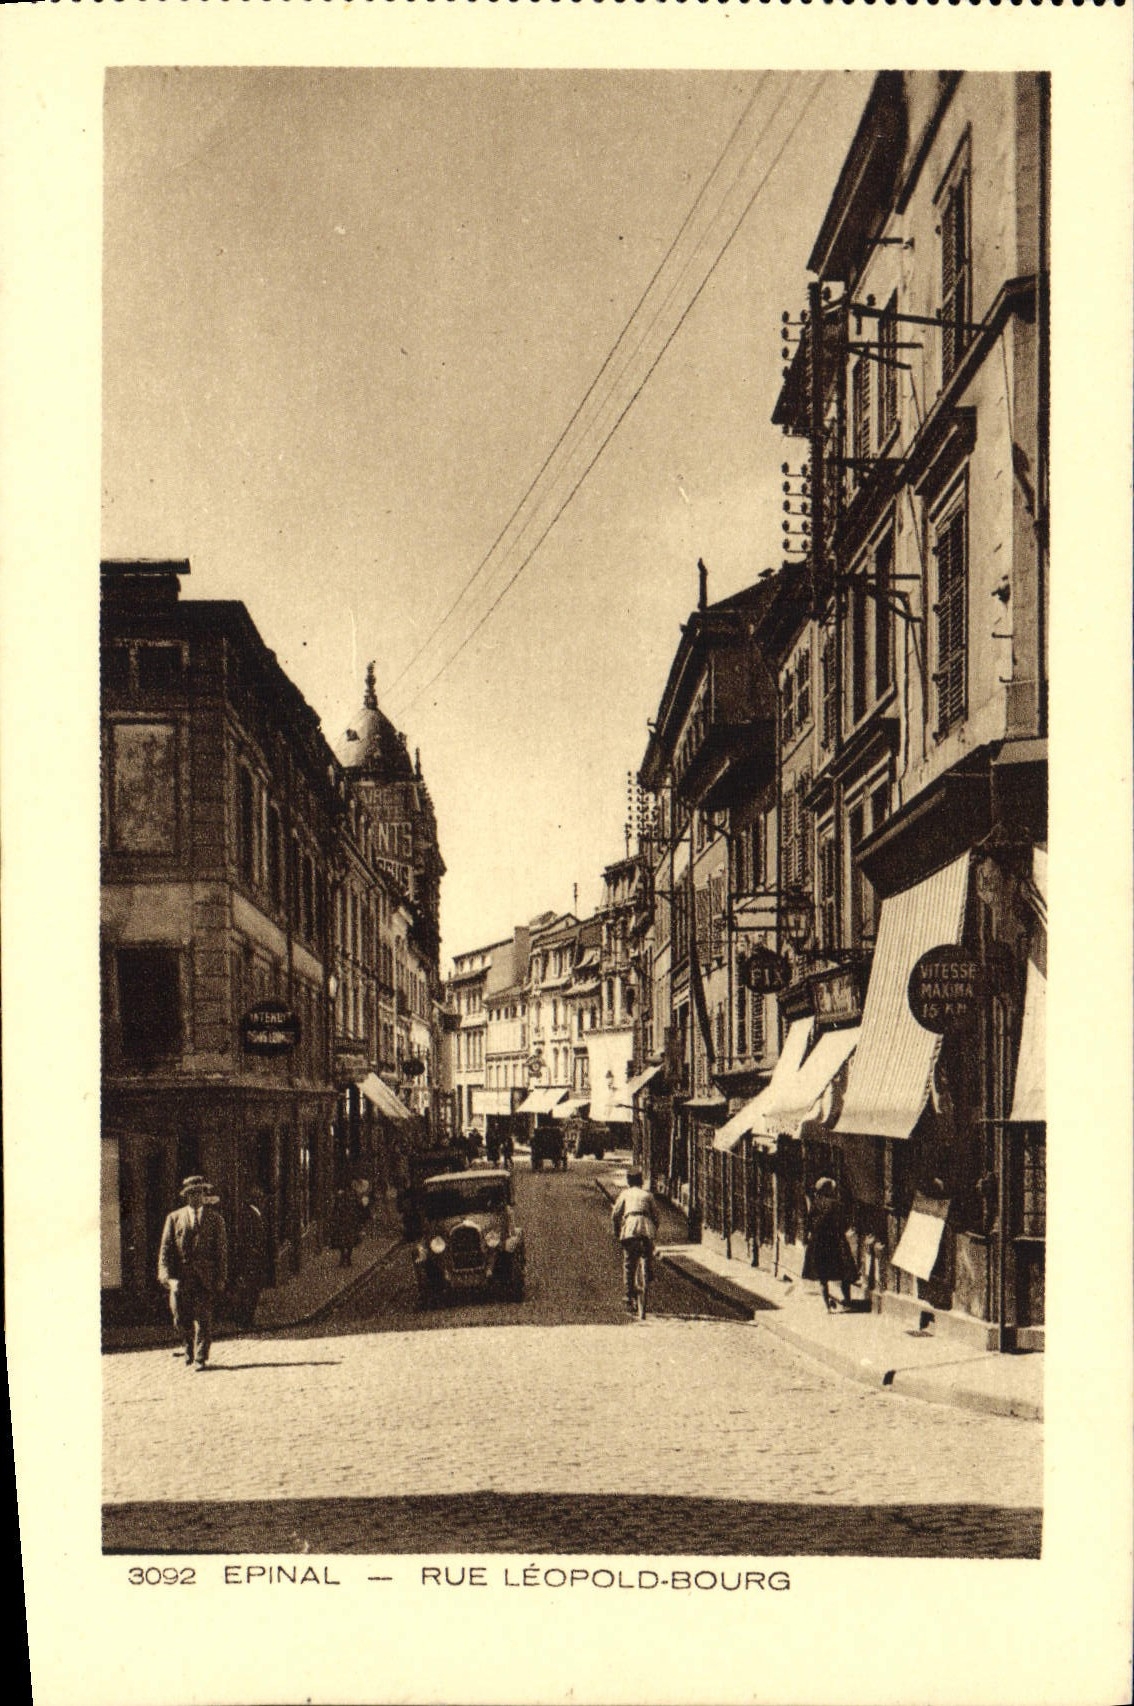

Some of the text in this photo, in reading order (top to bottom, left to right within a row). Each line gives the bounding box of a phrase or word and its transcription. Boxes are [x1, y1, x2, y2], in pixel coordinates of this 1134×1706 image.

[920, 962, 977, 979] VITESSE
[920, 983, 974, 999] MAXIMA
[922, 1002, 940, 1019] 15
